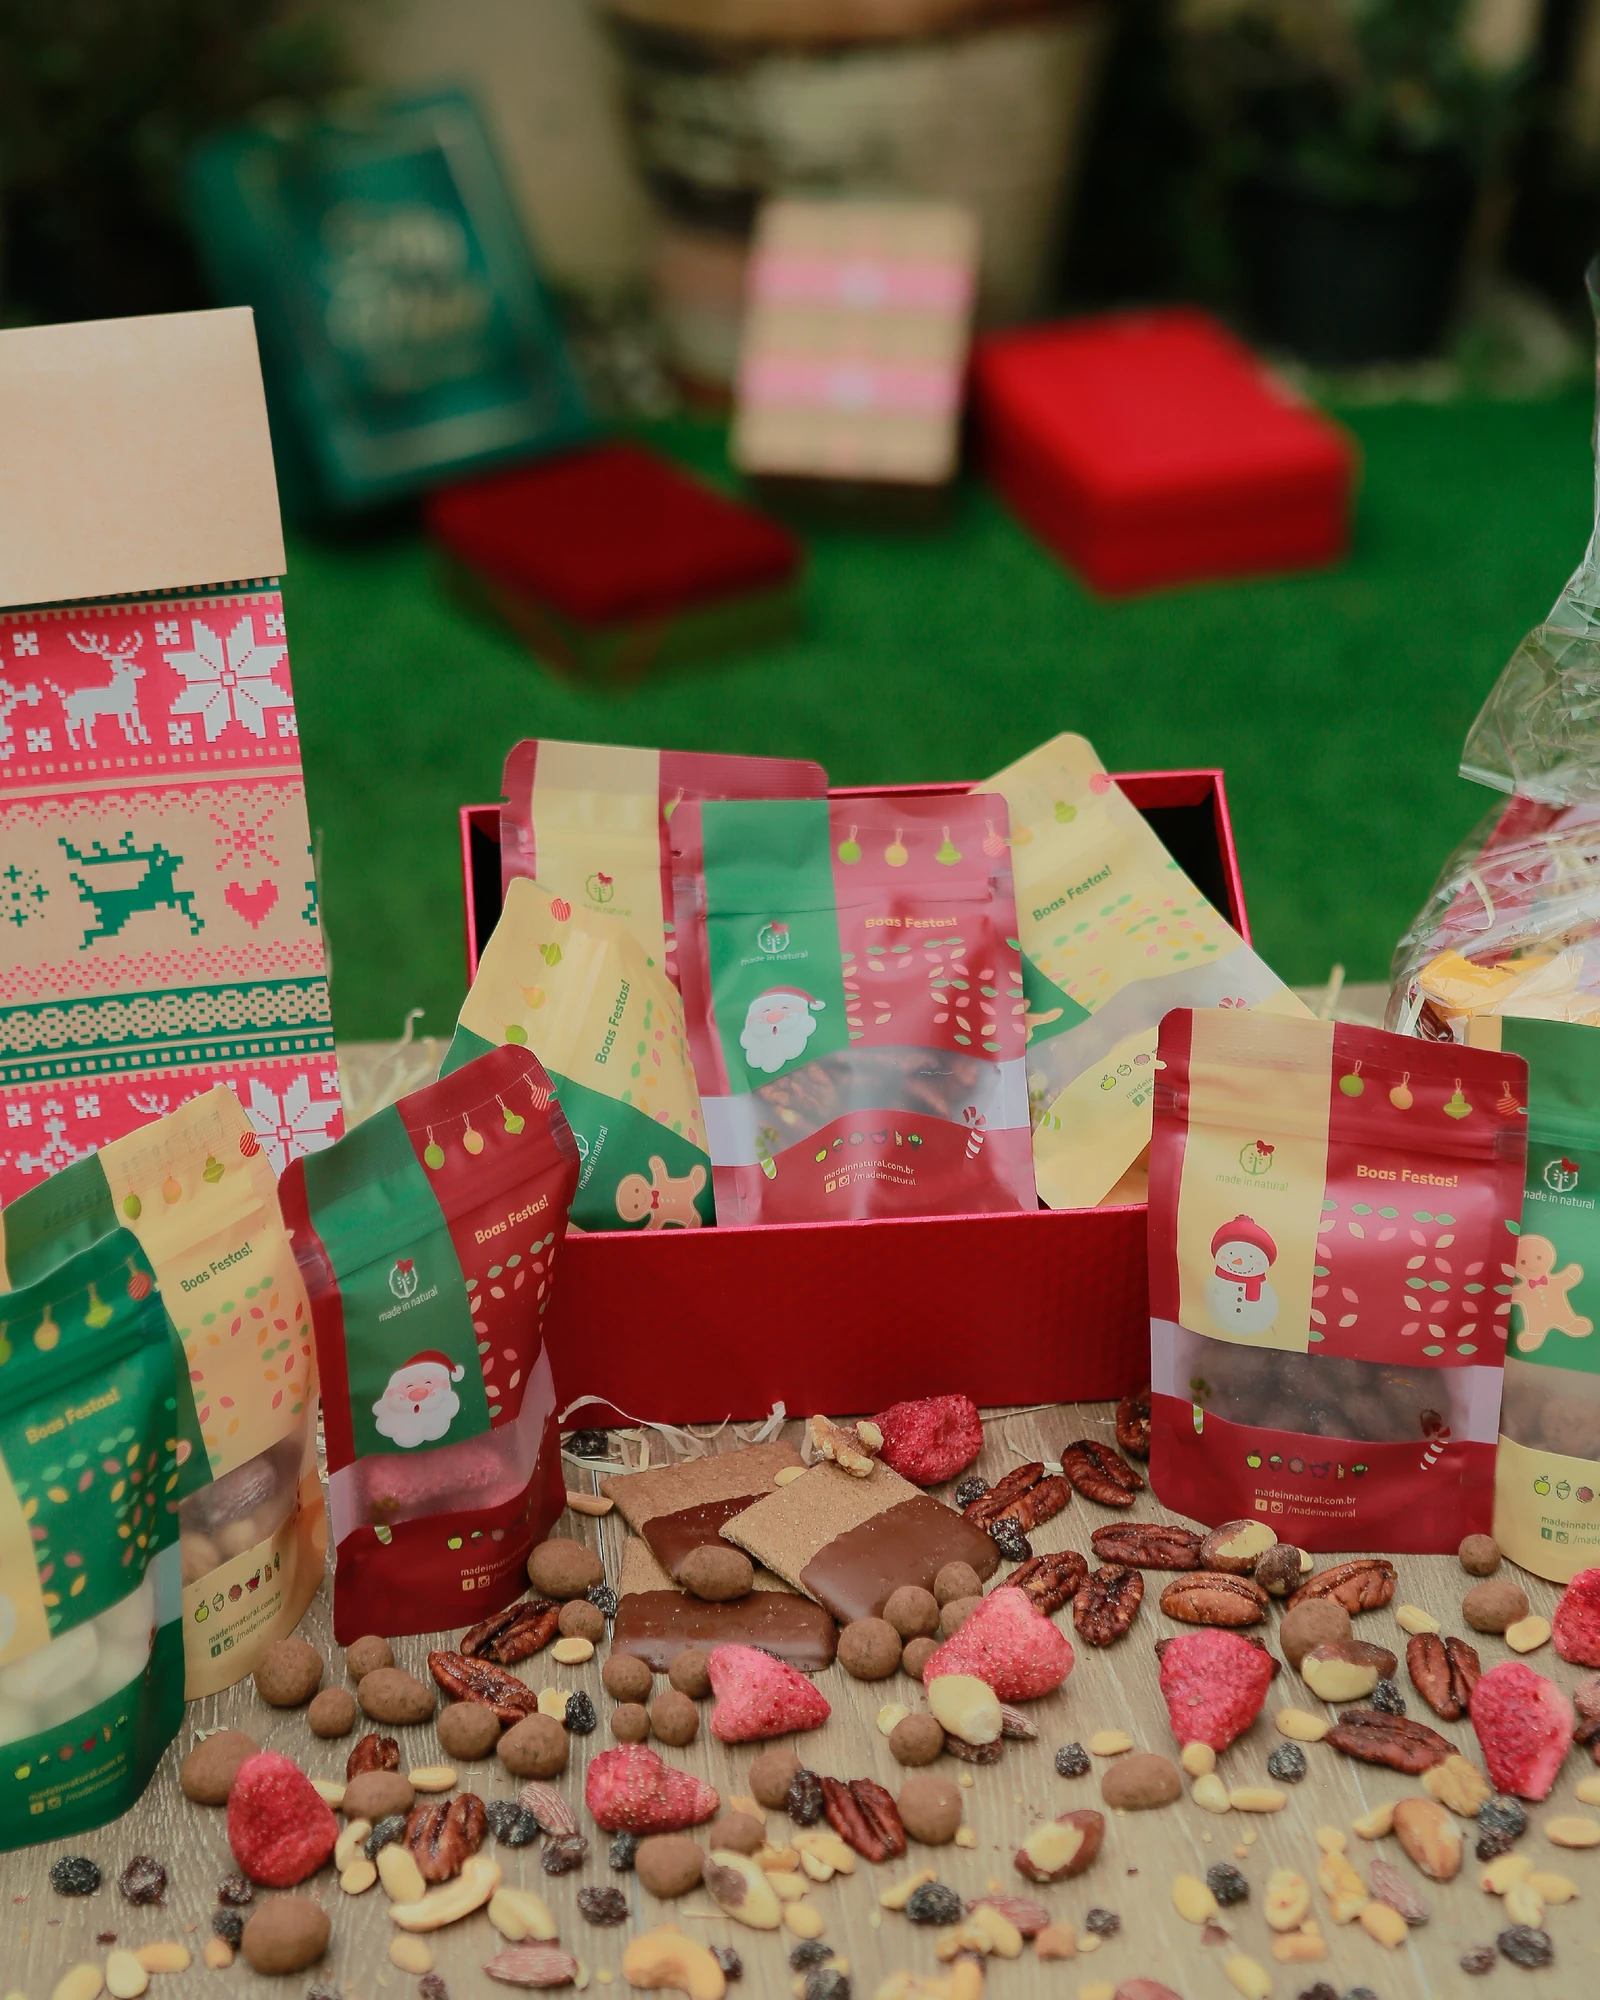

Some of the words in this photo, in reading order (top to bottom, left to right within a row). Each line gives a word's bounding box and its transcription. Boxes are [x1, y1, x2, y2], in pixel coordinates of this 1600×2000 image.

[1032, 897, 1066, 921] Boas
[1066, 864, 1112, 900] Festas!
[865, 917, 901, 929] Boas
[905, 916, 958, 929] Festas!
[741, 954, 765, 966] made
[766, 952, 775, 961] in
[776, 950, 809, 961] natural
[594, 1029, 617, 1065] Boas
[608, 979, 630, 1027] Festas!
[592, 1125, 608, 1157] natural
[587, 1155, 598, 1166] in
[824, 1159, 915, 1181] madeinnatural.com.br
[578, 1165, 594, 1190] made
[853, 1171, 917, 1186] /madeinnatural
[1215, 1173, 1242, 1185] made
[1244, 1175, 1252, 1186] in
[1253, 1179, 1289, 1192] natural
[1357, 1164, 1397, 1181] Boas
[1401, 1169, 1459, 1188] Festas!
[1549, 1192, 1558, 1203] in
[1559, 1196, 1595, 1210] natural
[474, 1221, 507, 1245] Boas
[507, 1194, 549, 1227] Festas!
[180, 1271, 210, 1293] Boas
[208, 1241, 253, 1275] Festas!
[378, 1305, 402, 1322] made
[401, 1301, 410, 1312] in
[410, 1284, 438, 1308] natural
[25, 1416, 66, 1445] Boas
[65, 1387, 120, 1426] Festas!
[1286, 1505, 1356, 1518] /madeinnatural
